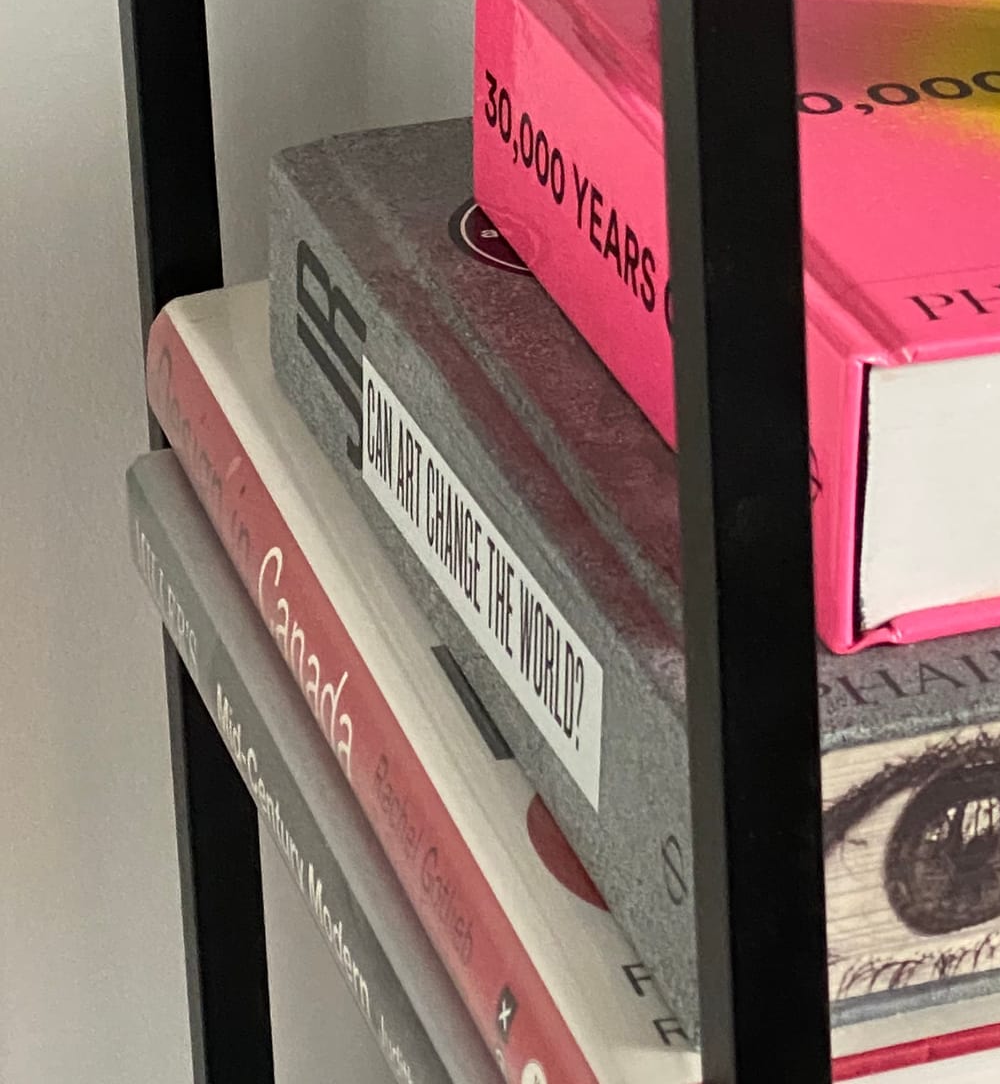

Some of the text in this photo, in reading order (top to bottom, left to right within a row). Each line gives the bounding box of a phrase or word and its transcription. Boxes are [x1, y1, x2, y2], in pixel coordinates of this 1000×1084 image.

[485, 70, 656, 312] 30,000 YEARS
[258, 546, 353, 784] Canada
[367, 379, 585, 751] CAN ART CHANGE THE WORLD?
[307, 862, 371, 1019] Modern
